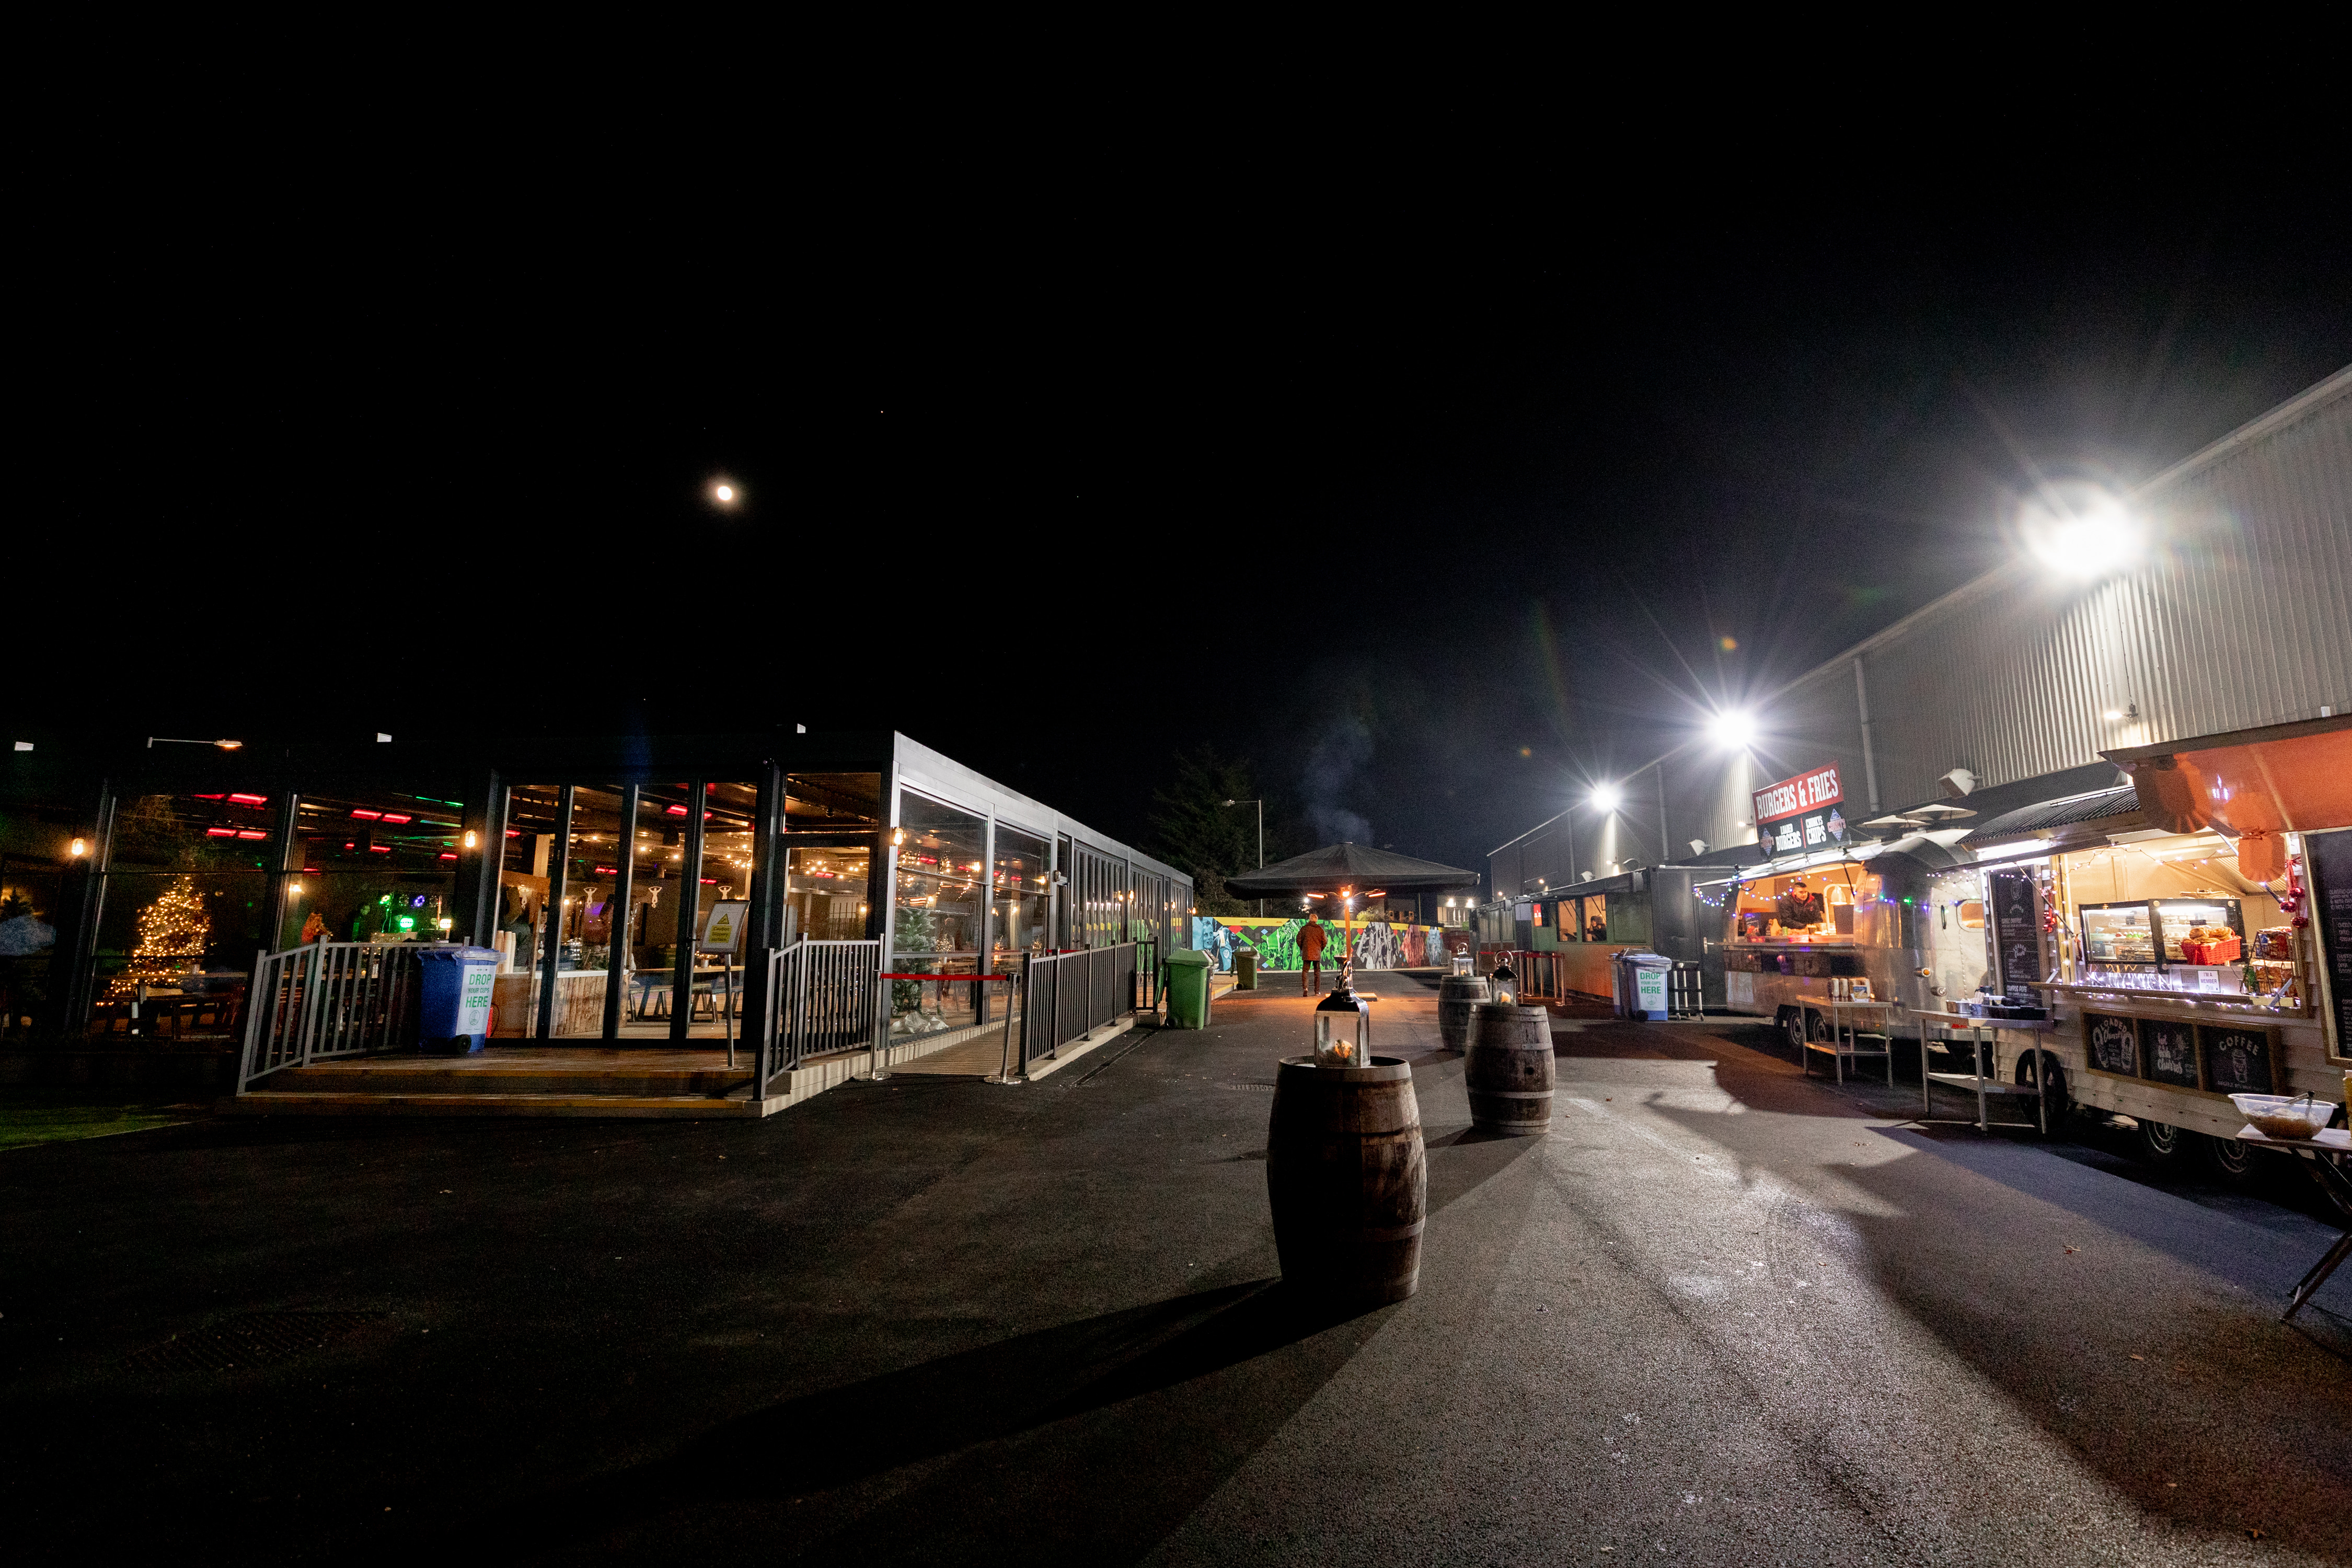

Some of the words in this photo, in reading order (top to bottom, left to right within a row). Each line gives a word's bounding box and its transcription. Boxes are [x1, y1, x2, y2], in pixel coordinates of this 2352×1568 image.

[1756, 784, 1797, 820] BURGERS
[1798, 780, 1807, 807] &
[1807, 769, 1839, 804] FRIES
[1775, 831, 1802, 851] BURGERS
[1806, 825, 1827, 845] CHIPS
[469, 974, 491, 985] DROP
[465, 996, 488, 1008] HERE
[2101, 1018, 2127, 1033] LOADED
[2219, 1035, 2259, 1055] COFFEE
